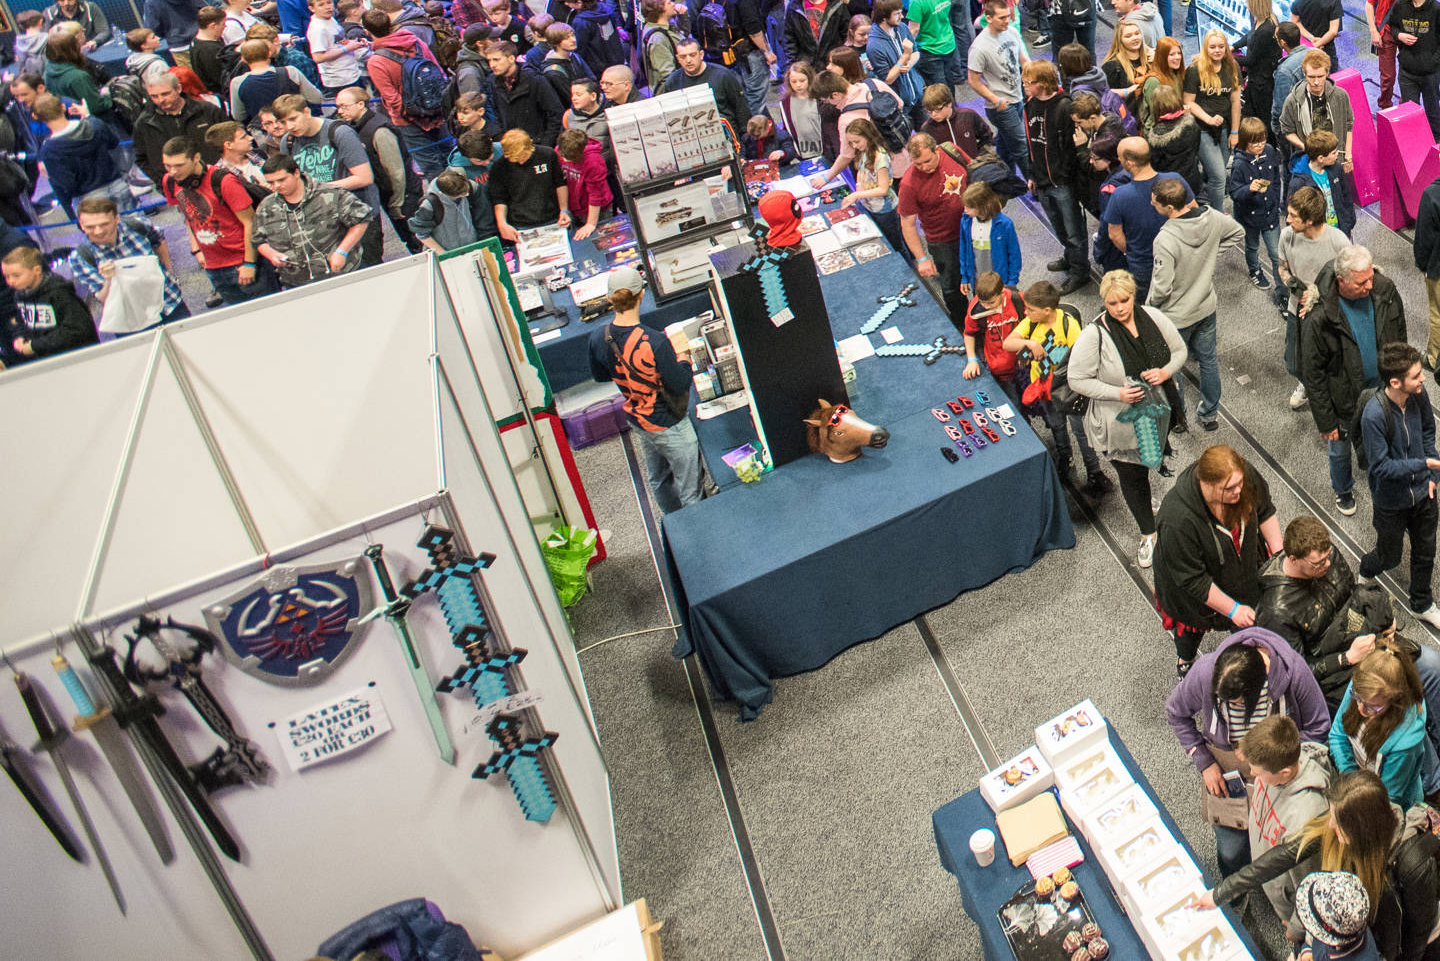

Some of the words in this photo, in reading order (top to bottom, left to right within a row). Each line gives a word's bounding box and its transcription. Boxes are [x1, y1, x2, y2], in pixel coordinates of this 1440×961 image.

[288, 694, 361, 728] LATEX
[289, 702, 370, 739] SWORDS
[326, 710, 371, 735] EACH
[299, 751, 310, 763] 2
[313, 739, 345, 758] FOR
